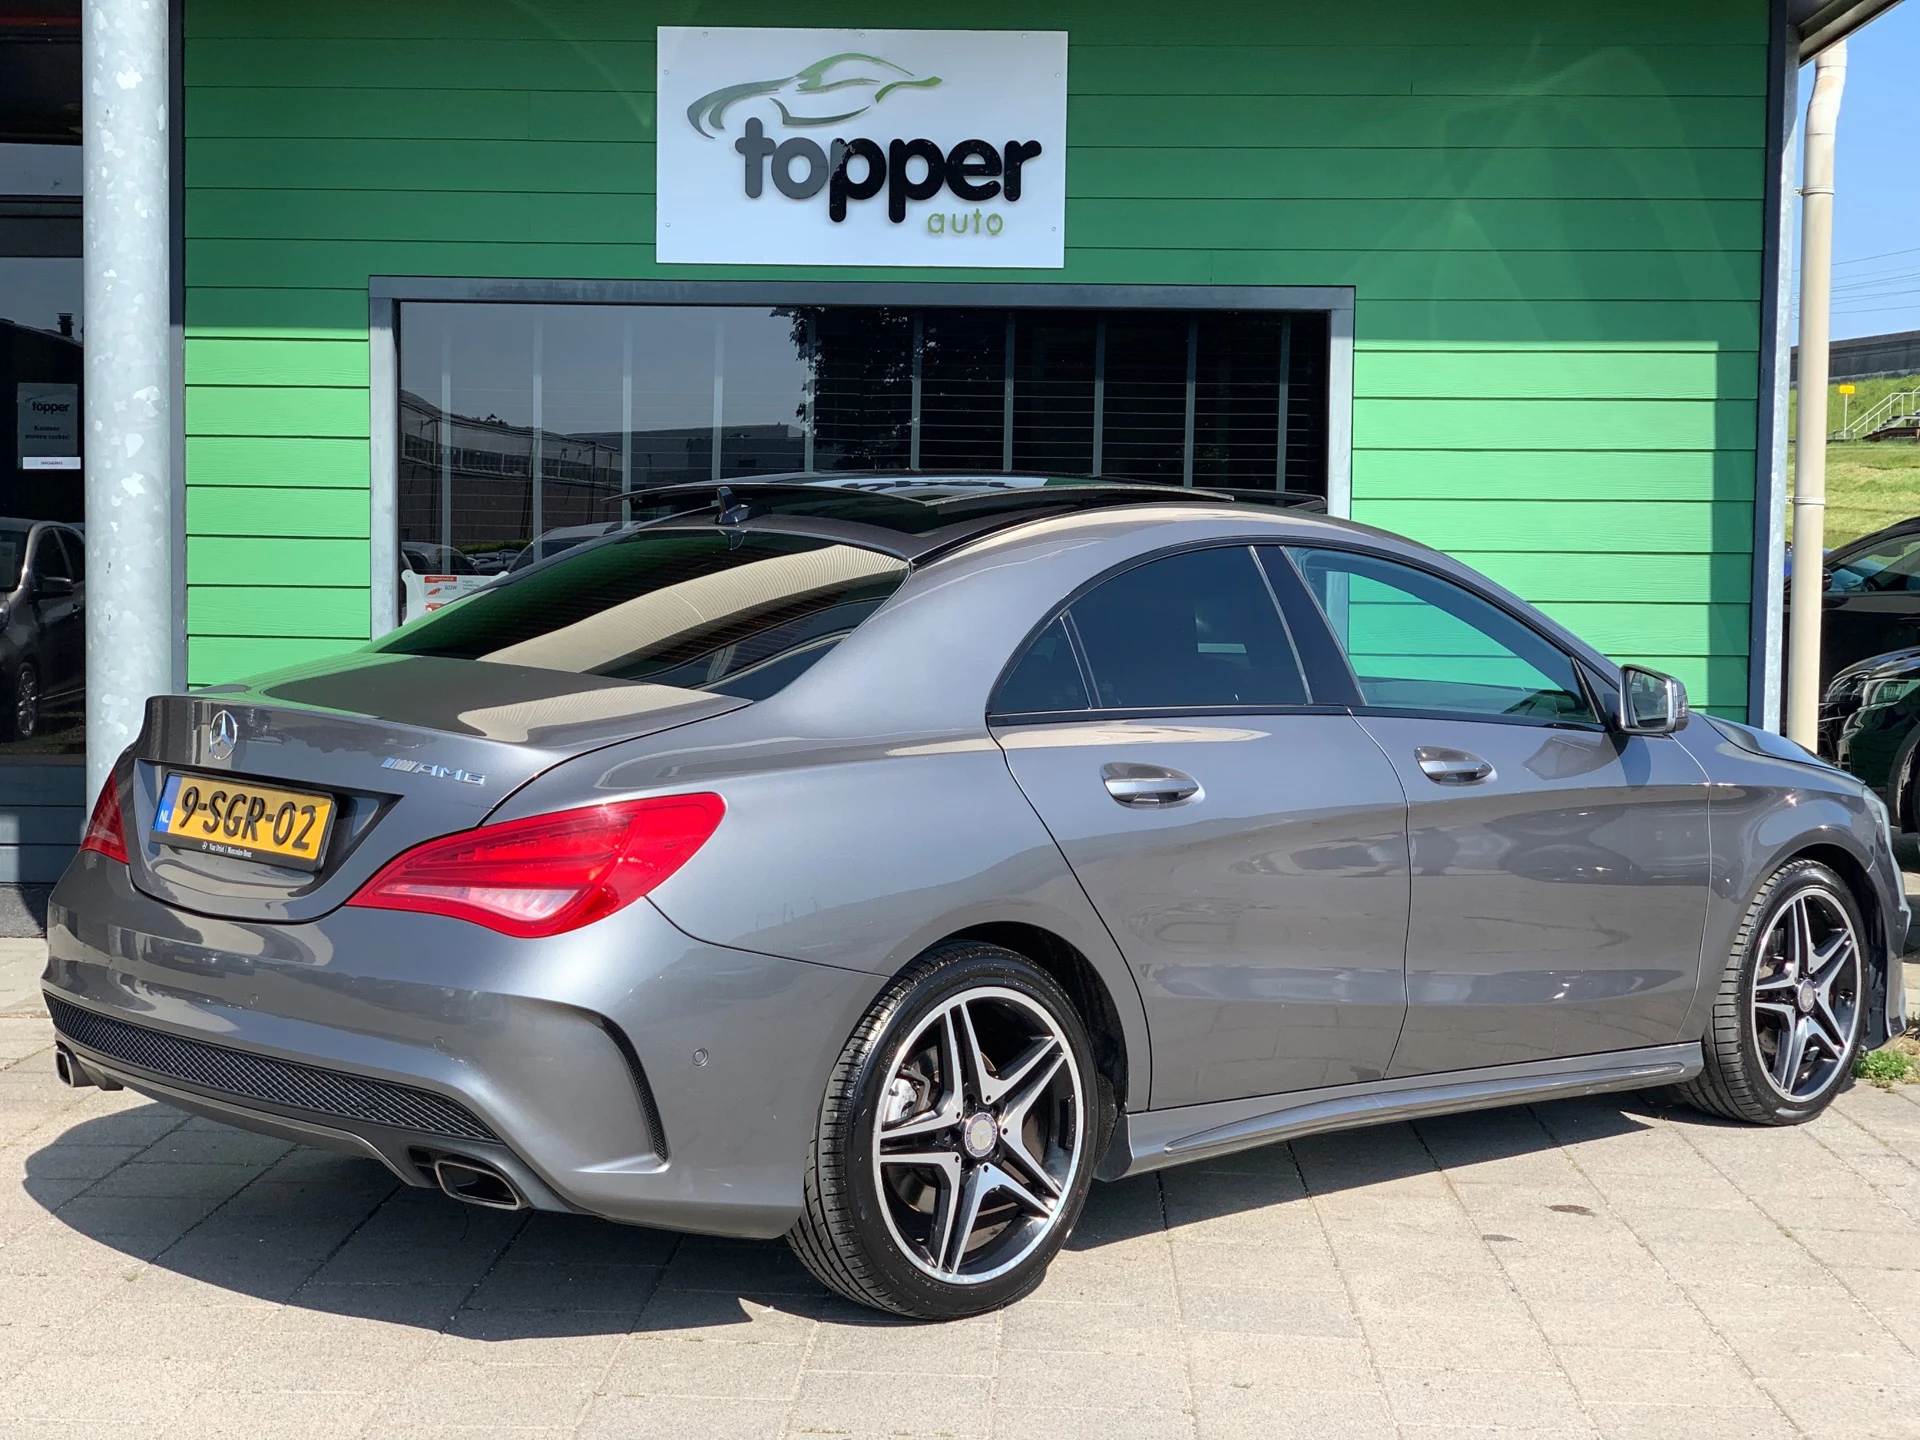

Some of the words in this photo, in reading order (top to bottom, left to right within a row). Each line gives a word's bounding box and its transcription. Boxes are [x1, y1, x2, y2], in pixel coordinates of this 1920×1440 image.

[735, 117, 1042, 223] topper
[928, 209, 1004, 235] auto
[32, 401, 70, 414] topper
[411, 763, 486, 785] AMG
[159, 810, 170, 824] NL
[178, 785, 317, 851] 9-SGR-02
